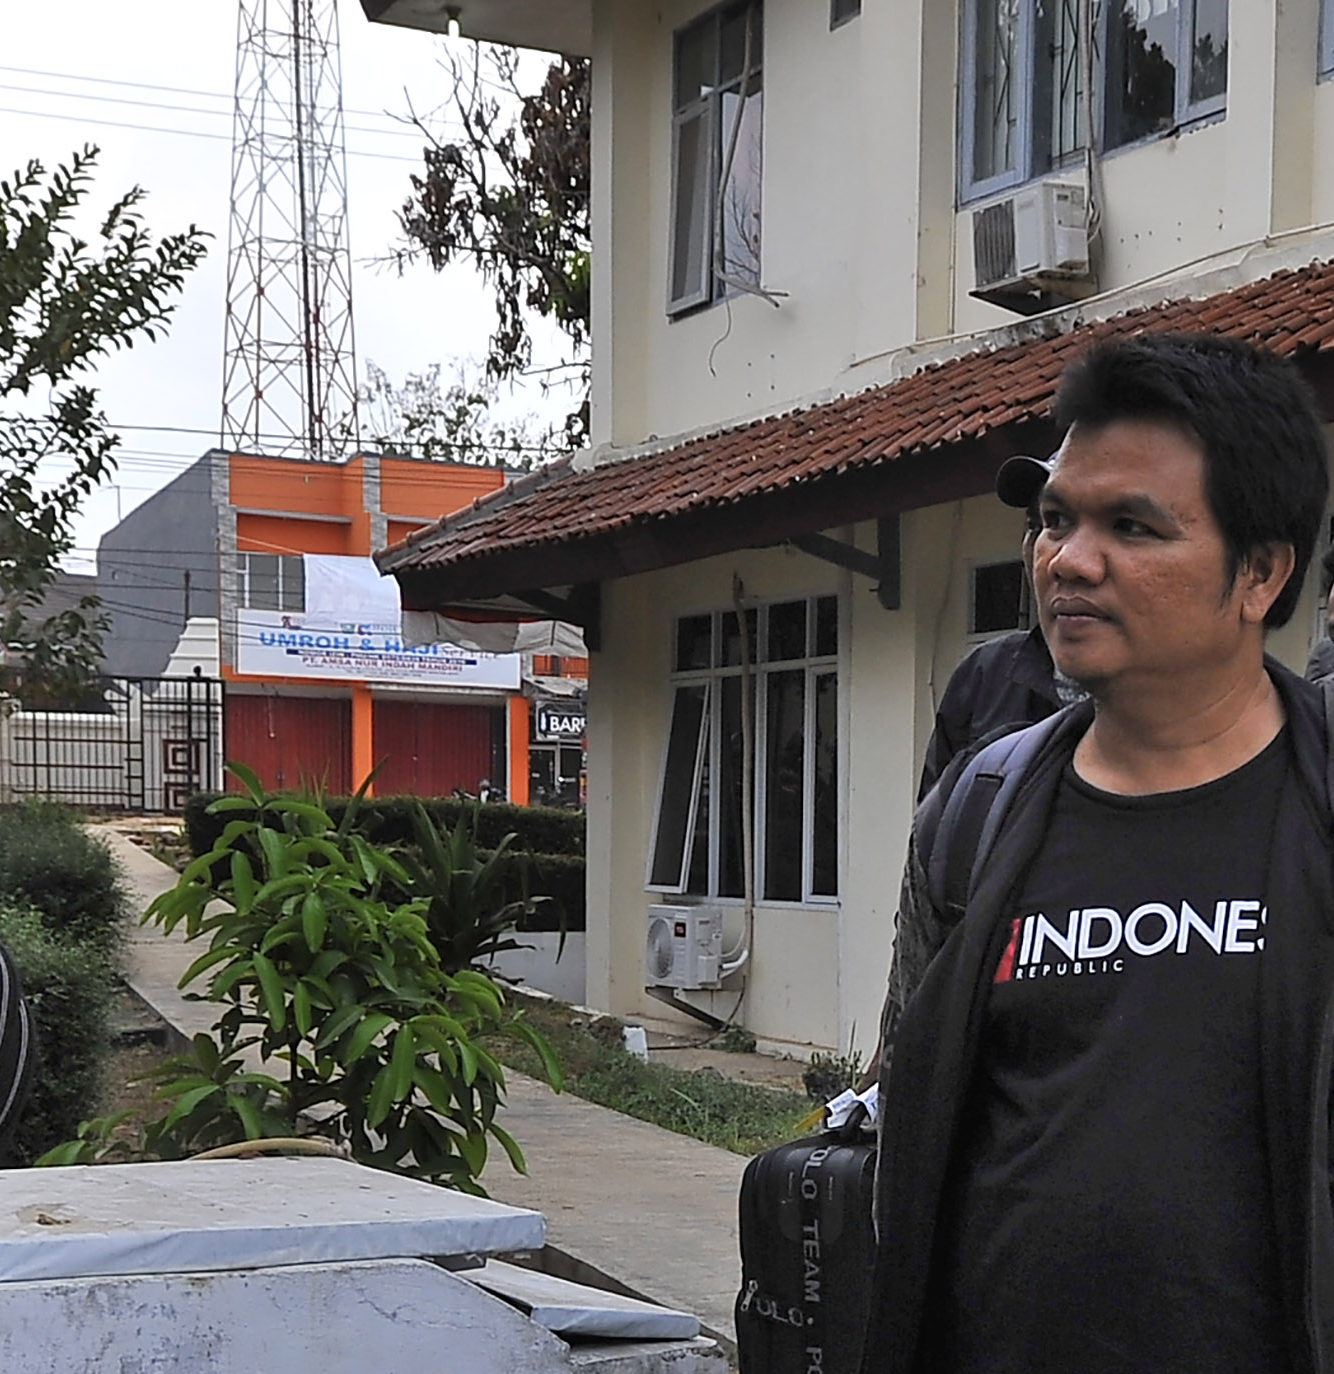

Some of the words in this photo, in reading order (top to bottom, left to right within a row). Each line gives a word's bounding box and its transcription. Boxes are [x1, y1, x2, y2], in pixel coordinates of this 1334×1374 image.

[260, 632, 350, 650] UMROH
[359, 638, 375, 651] &
[355, 659, 378, 668] NUR
[381, 661, 415, 670] INDAH
[418, 662, 463, 673] MANDIRI
[1015, 960, 1124, 980] REPUBLIC
[802, 1218, 821, 1303] TEAM
